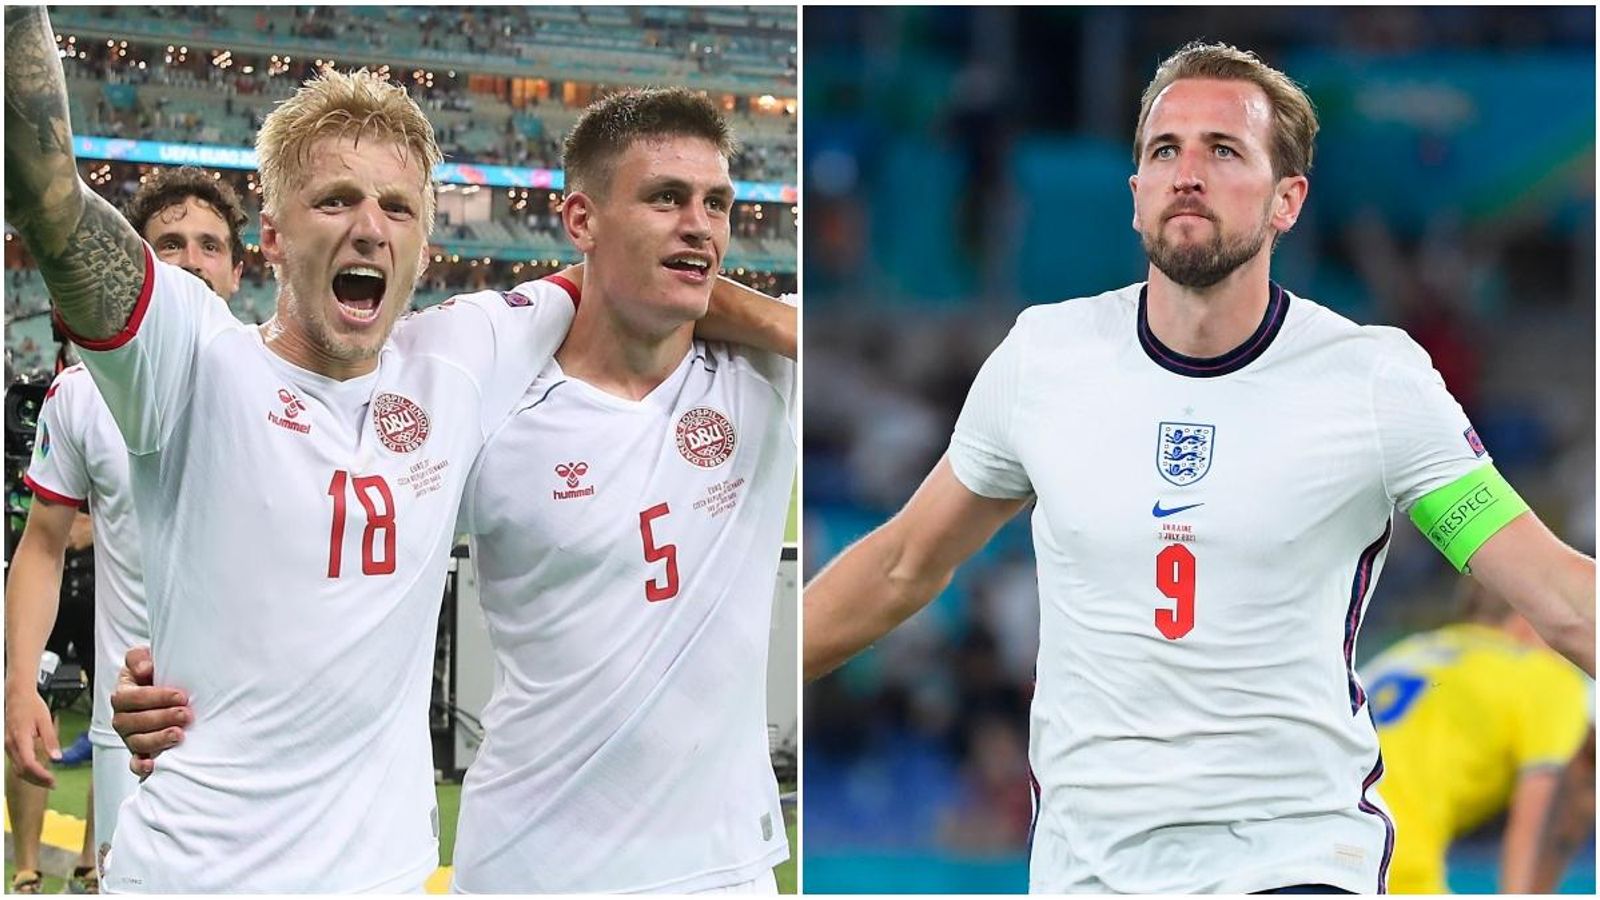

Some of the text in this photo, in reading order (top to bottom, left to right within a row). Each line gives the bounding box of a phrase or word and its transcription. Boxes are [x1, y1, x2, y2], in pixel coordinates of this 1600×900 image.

[268, 410, 311, 434] hummel
[380, 410, 417, 436] DBU
[684, 424, 725, 450] DBU
[553, 485, 594, 500] hummel
[328, 470, 396, 578] 18
[1439, 486, 1493, 537] RESPECT
[1162, 523, 1192, 533] UKRAINE
[1164, 532, 1180, 541] JULY
[639, 502, 679, 602] 5
[1155, 544, 1195, 640] 9
